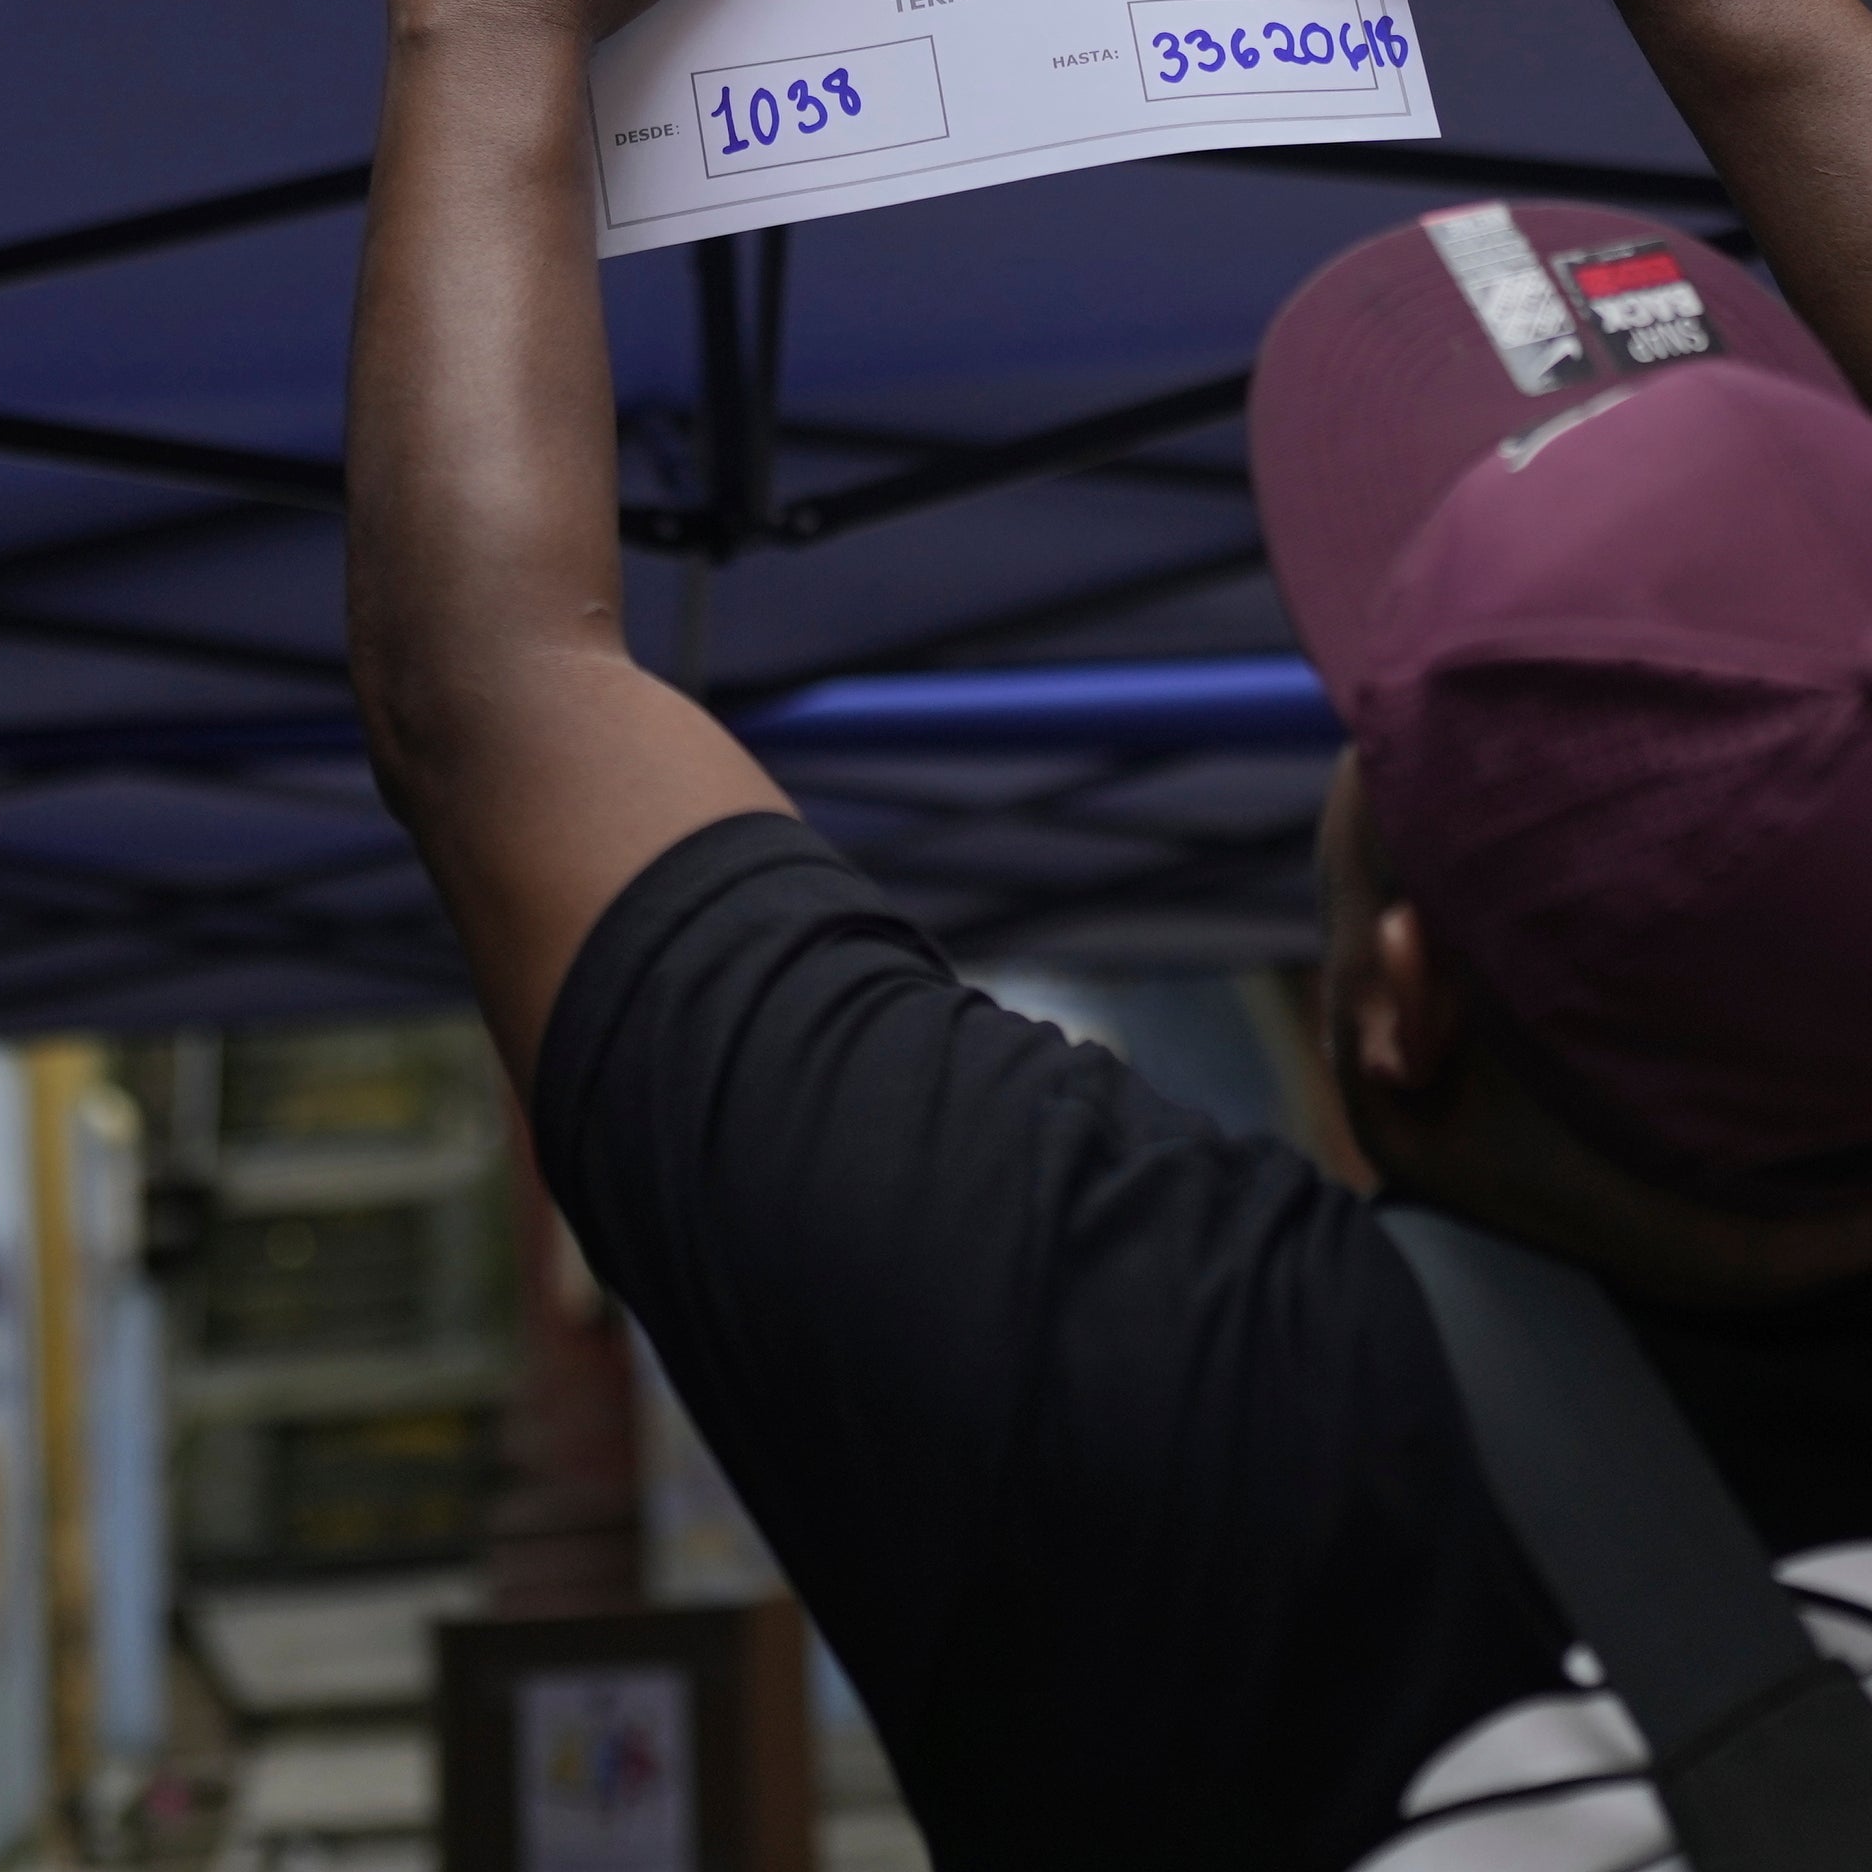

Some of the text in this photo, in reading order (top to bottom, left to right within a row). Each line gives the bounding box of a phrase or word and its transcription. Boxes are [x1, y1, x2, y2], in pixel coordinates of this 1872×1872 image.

[1052, 48, 1120, 69] HASTA:
[711, 67, 862, 155] 1038
[615, 123, 681, 147] DESDE:
